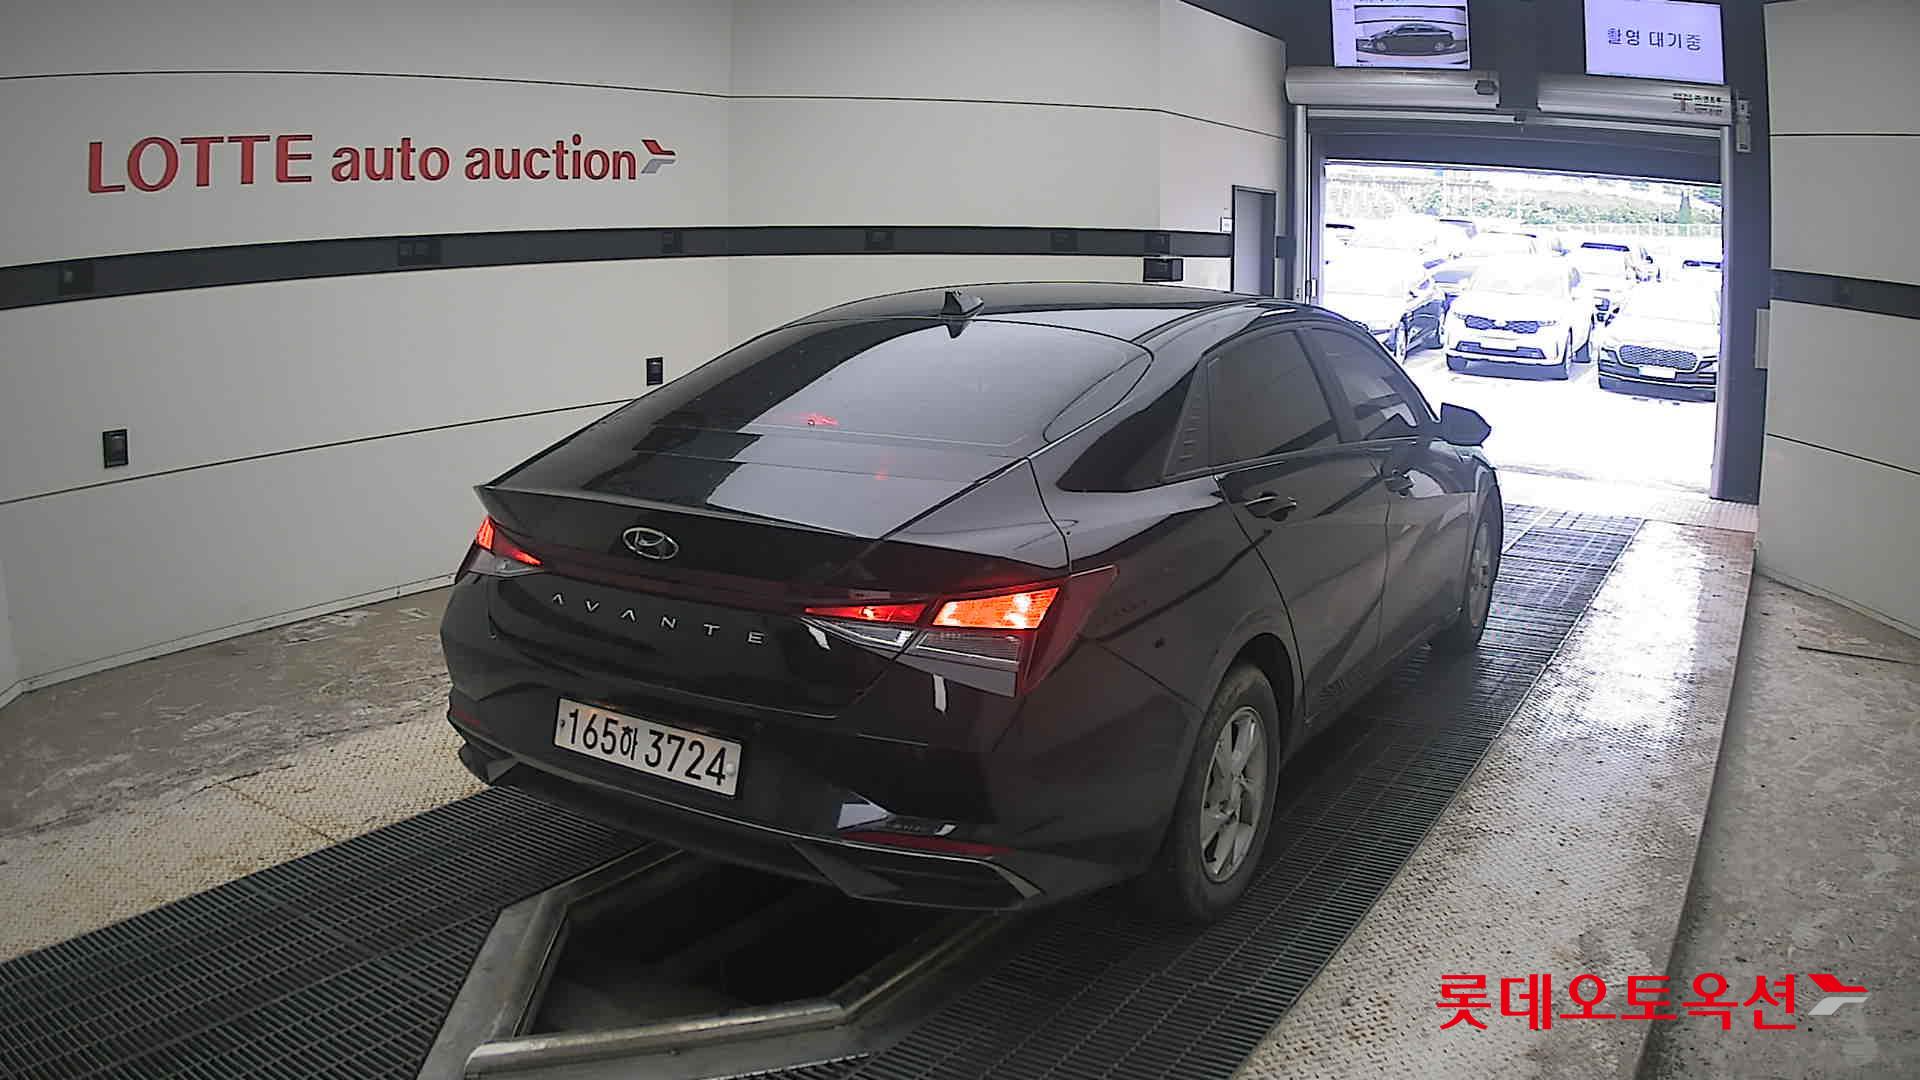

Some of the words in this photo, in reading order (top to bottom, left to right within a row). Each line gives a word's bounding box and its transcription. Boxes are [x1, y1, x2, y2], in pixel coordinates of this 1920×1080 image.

[1649, 31, 1701, 51] 대기중
[88, 134, 313, 194] LOTTE
[331, 137, 450, 182] auto
[464, 134, 637, 181] auction
[552, 592, 766, 645] AVANTE
